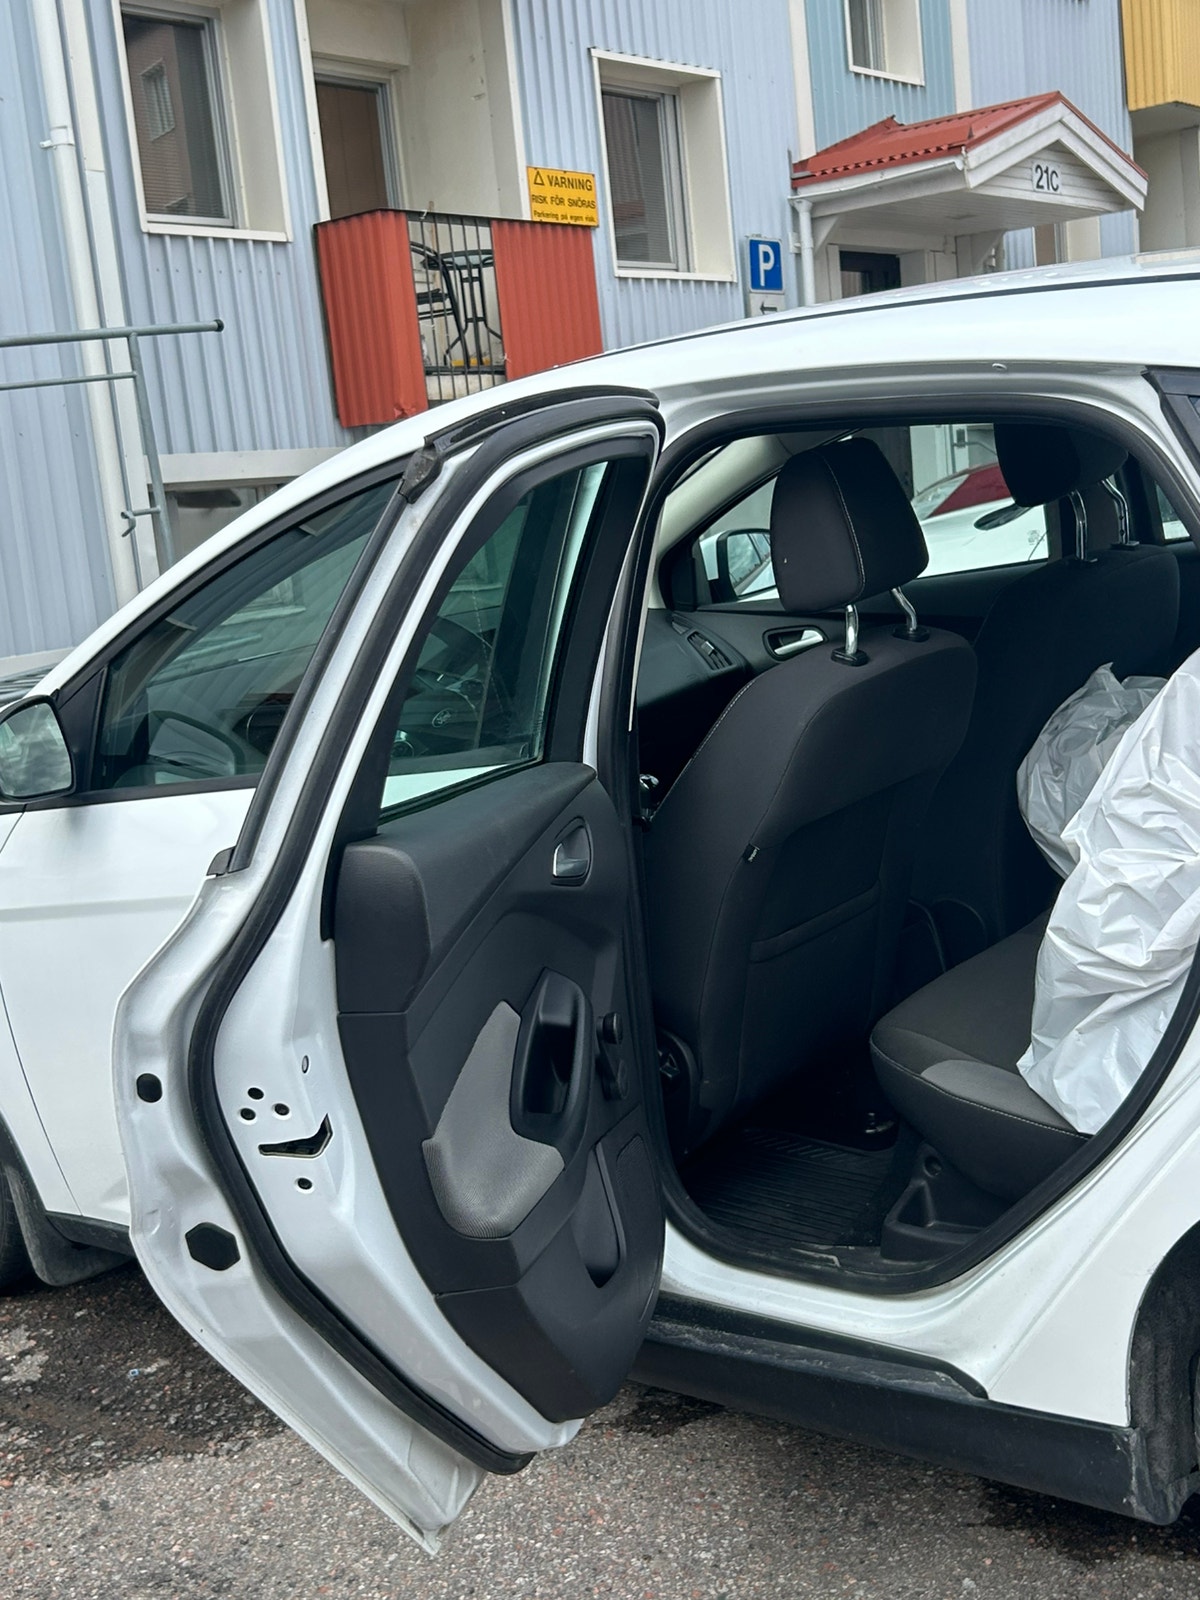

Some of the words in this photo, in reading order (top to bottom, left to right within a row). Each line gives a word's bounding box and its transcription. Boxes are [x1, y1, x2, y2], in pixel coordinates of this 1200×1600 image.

[547, 175, 593, 191] VARNING
[1035, 164, 1059, 192] 21C
[532, 194, 548, 205] RISK
[550, 195, 565, 206] FÖR
[567, 197, 596, 209] SNÖRAS
[758, 244, 775, 287] P
